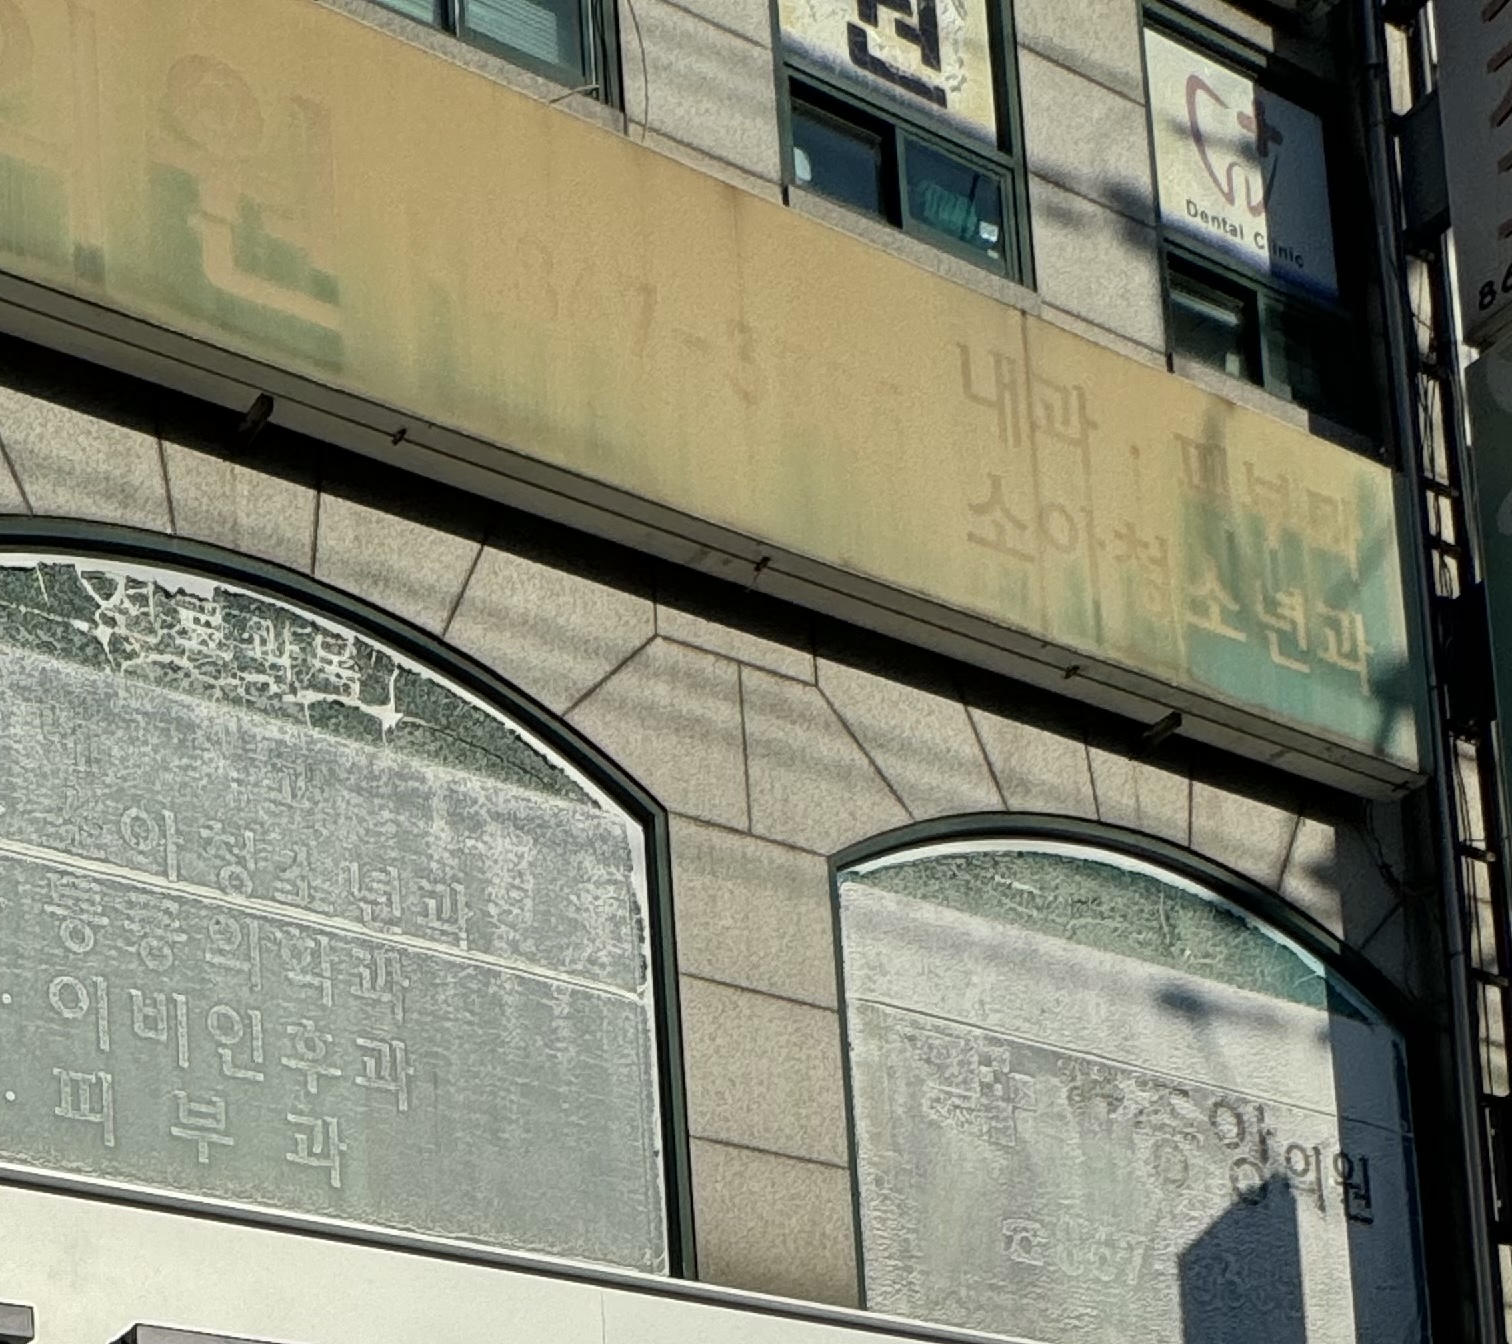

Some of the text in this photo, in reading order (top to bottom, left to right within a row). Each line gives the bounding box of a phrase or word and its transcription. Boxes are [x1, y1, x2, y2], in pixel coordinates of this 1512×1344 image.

[1186, 198, 1304, 268] Dental Cinic
[957, 343, 1099, 449] 내과
[967, 473, 1375, 697] 소아청소년과
[48, 976, 414, 1111] 이비인후과
[53, 1067, 346, 1188] 피부과
